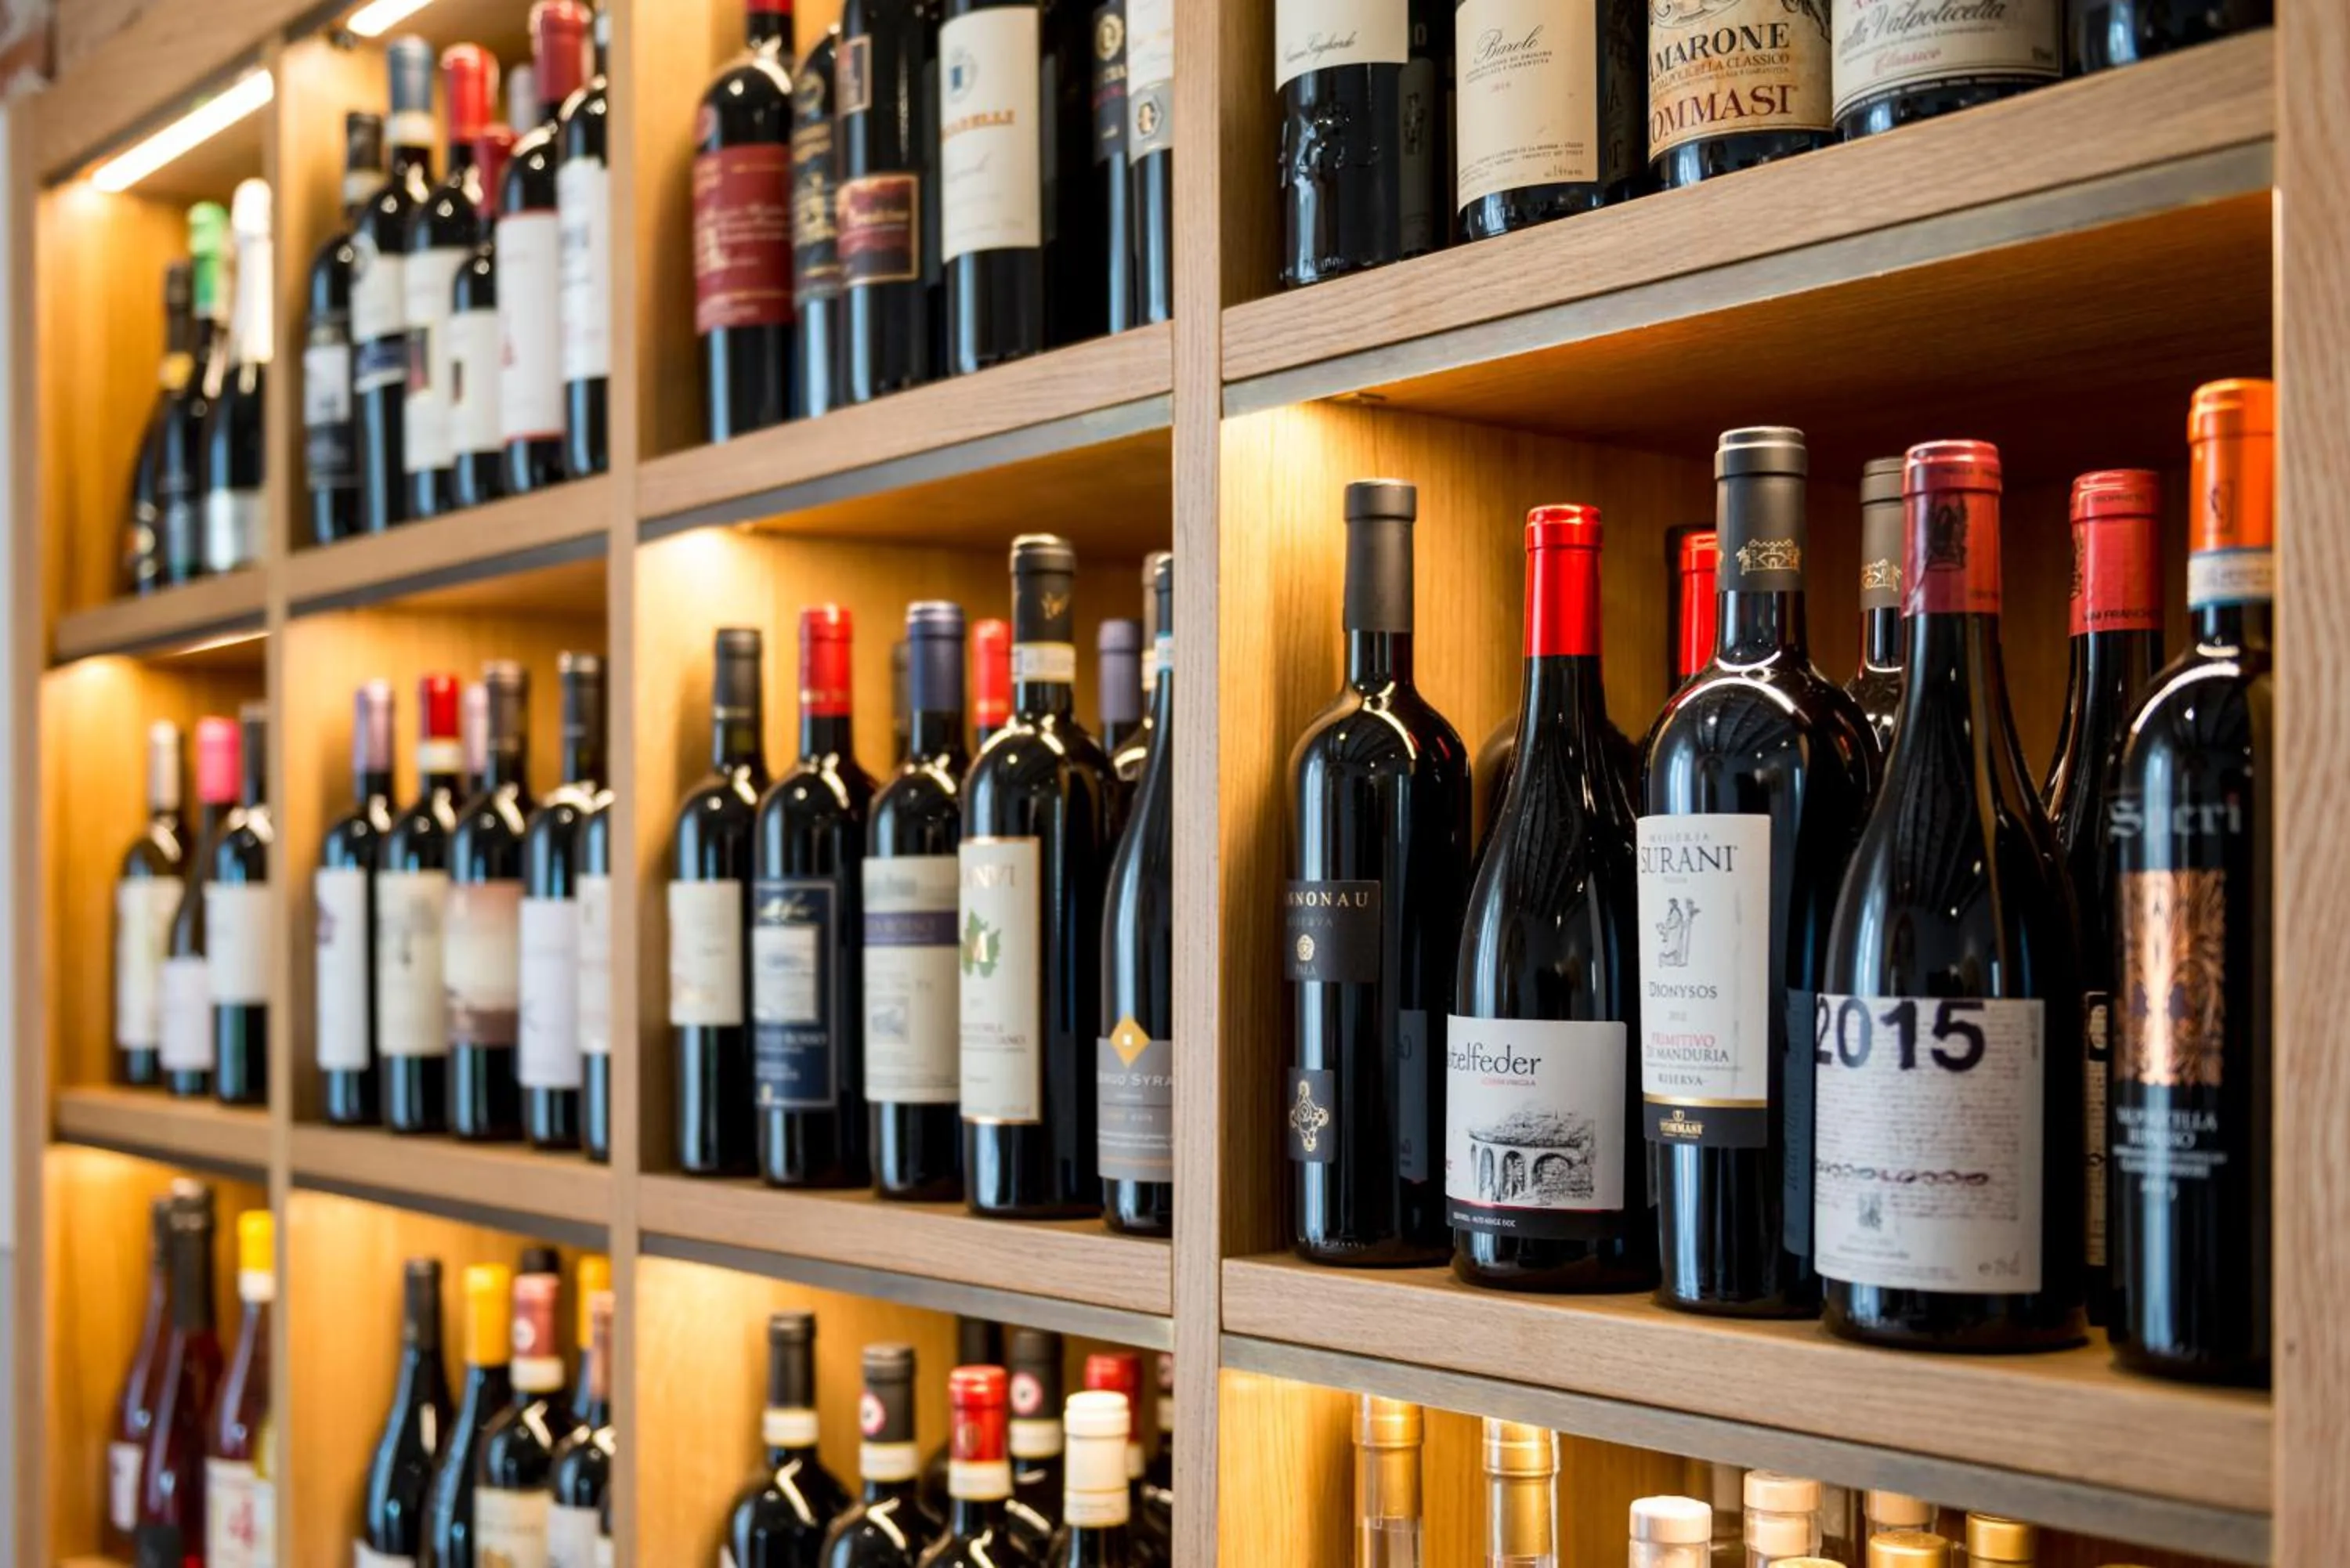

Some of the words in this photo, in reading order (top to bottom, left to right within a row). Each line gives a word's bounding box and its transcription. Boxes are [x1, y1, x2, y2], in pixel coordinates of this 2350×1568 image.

[1474, 24, 1544, 65] Barolo
[1726, 52, 1789, 69] CLASSICO
[1651, 84, 1793, 144] OMMASI
[1648, 981, 1718, 999] DIONYSOS
[1652, 1031, 1716, 1048] PRIMITIVO
[1817, 996, 1986, 1073] 2015
[1656, 1047, 1730, 1063] MANDURIA
[1131, 1073, 1174, 1087] SYRA
[1658, 1073, 1703, 1086] RISERVA
